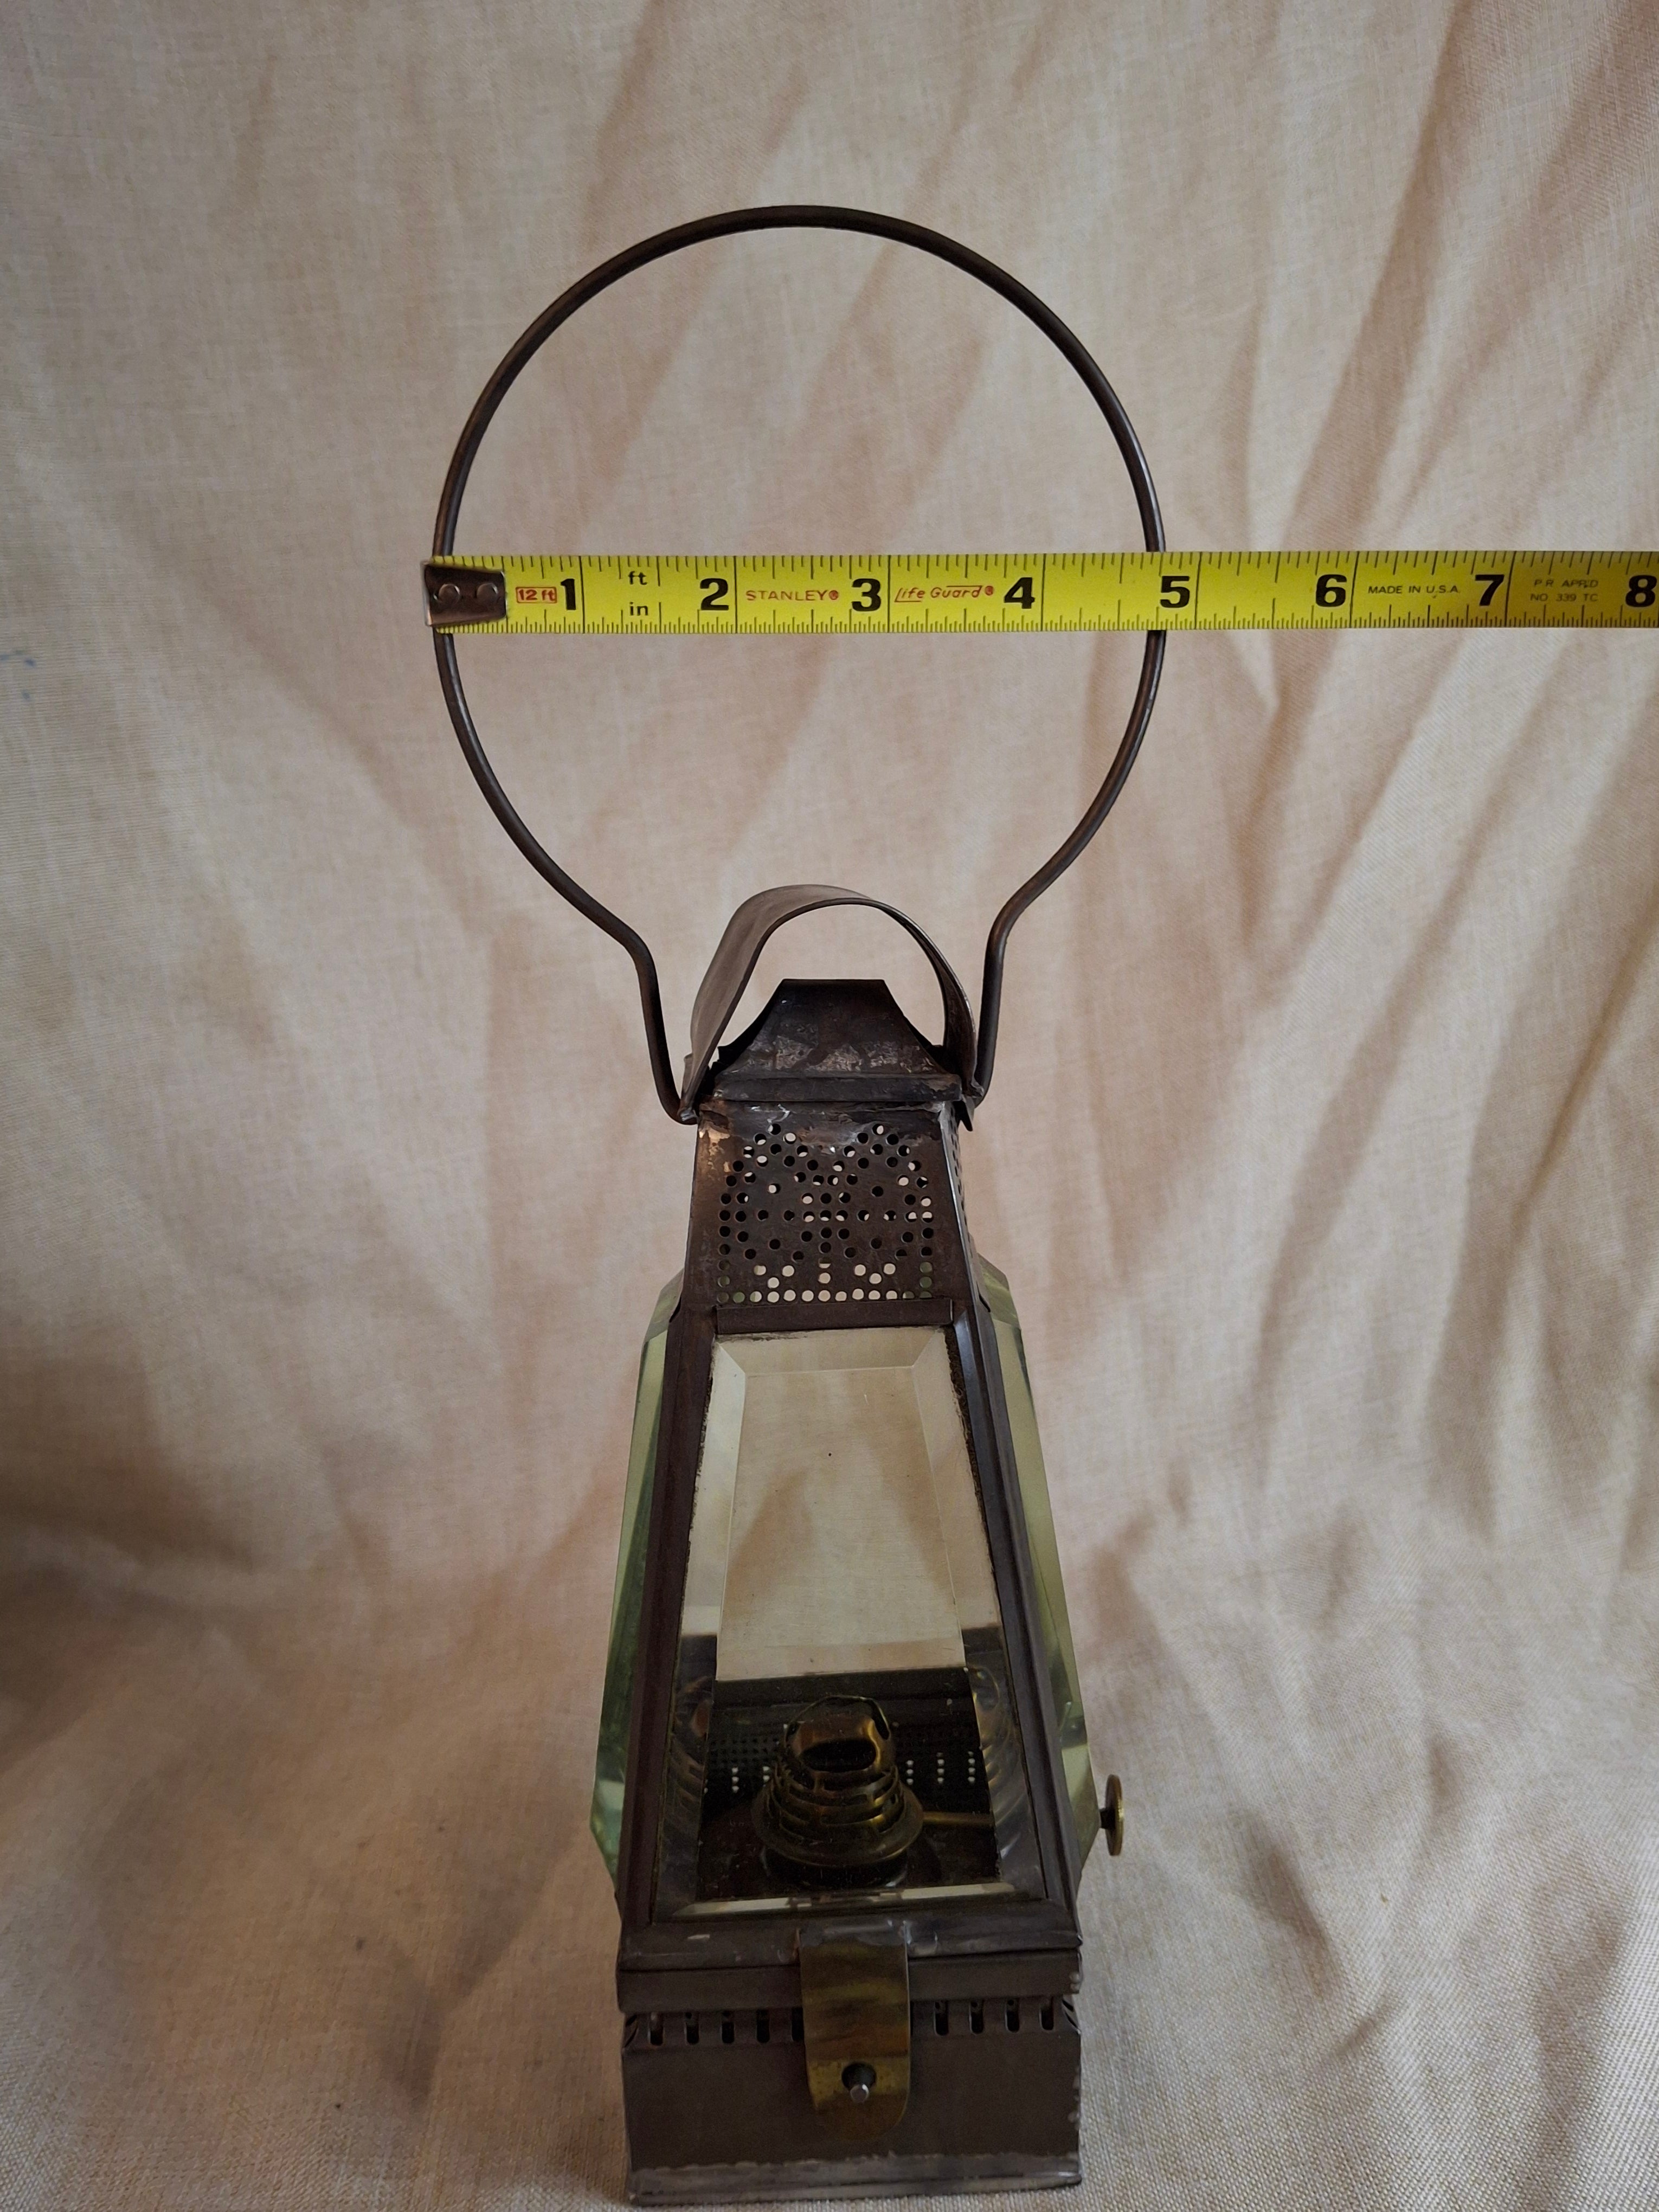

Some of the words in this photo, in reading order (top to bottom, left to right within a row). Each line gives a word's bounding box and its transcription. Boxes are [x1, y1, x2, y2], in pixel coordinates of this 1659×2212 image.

[561, 578, 576, 610] 1
[628, 570, 647, 586] ft
[699, 577, 729, 611] 2
[1004, 577, 1035, 609] 4
[1160, 575, 1190, 608] 5
[1315, 574, 1347, 607] 6
[1368, 585, 1403, 594] MADE
[1409, 585, 1422, 594] IN
[1475, 574, 1504, 606] 7
[1625, 575, 1657, 607] 8
[629, 602, 648, 616] in
[852, 578, 882, 612] 3
[894, 587, 925, 602] Life
[1530, 593, 1548, 601] NO
[1583, 593, 1598, 601] TC
